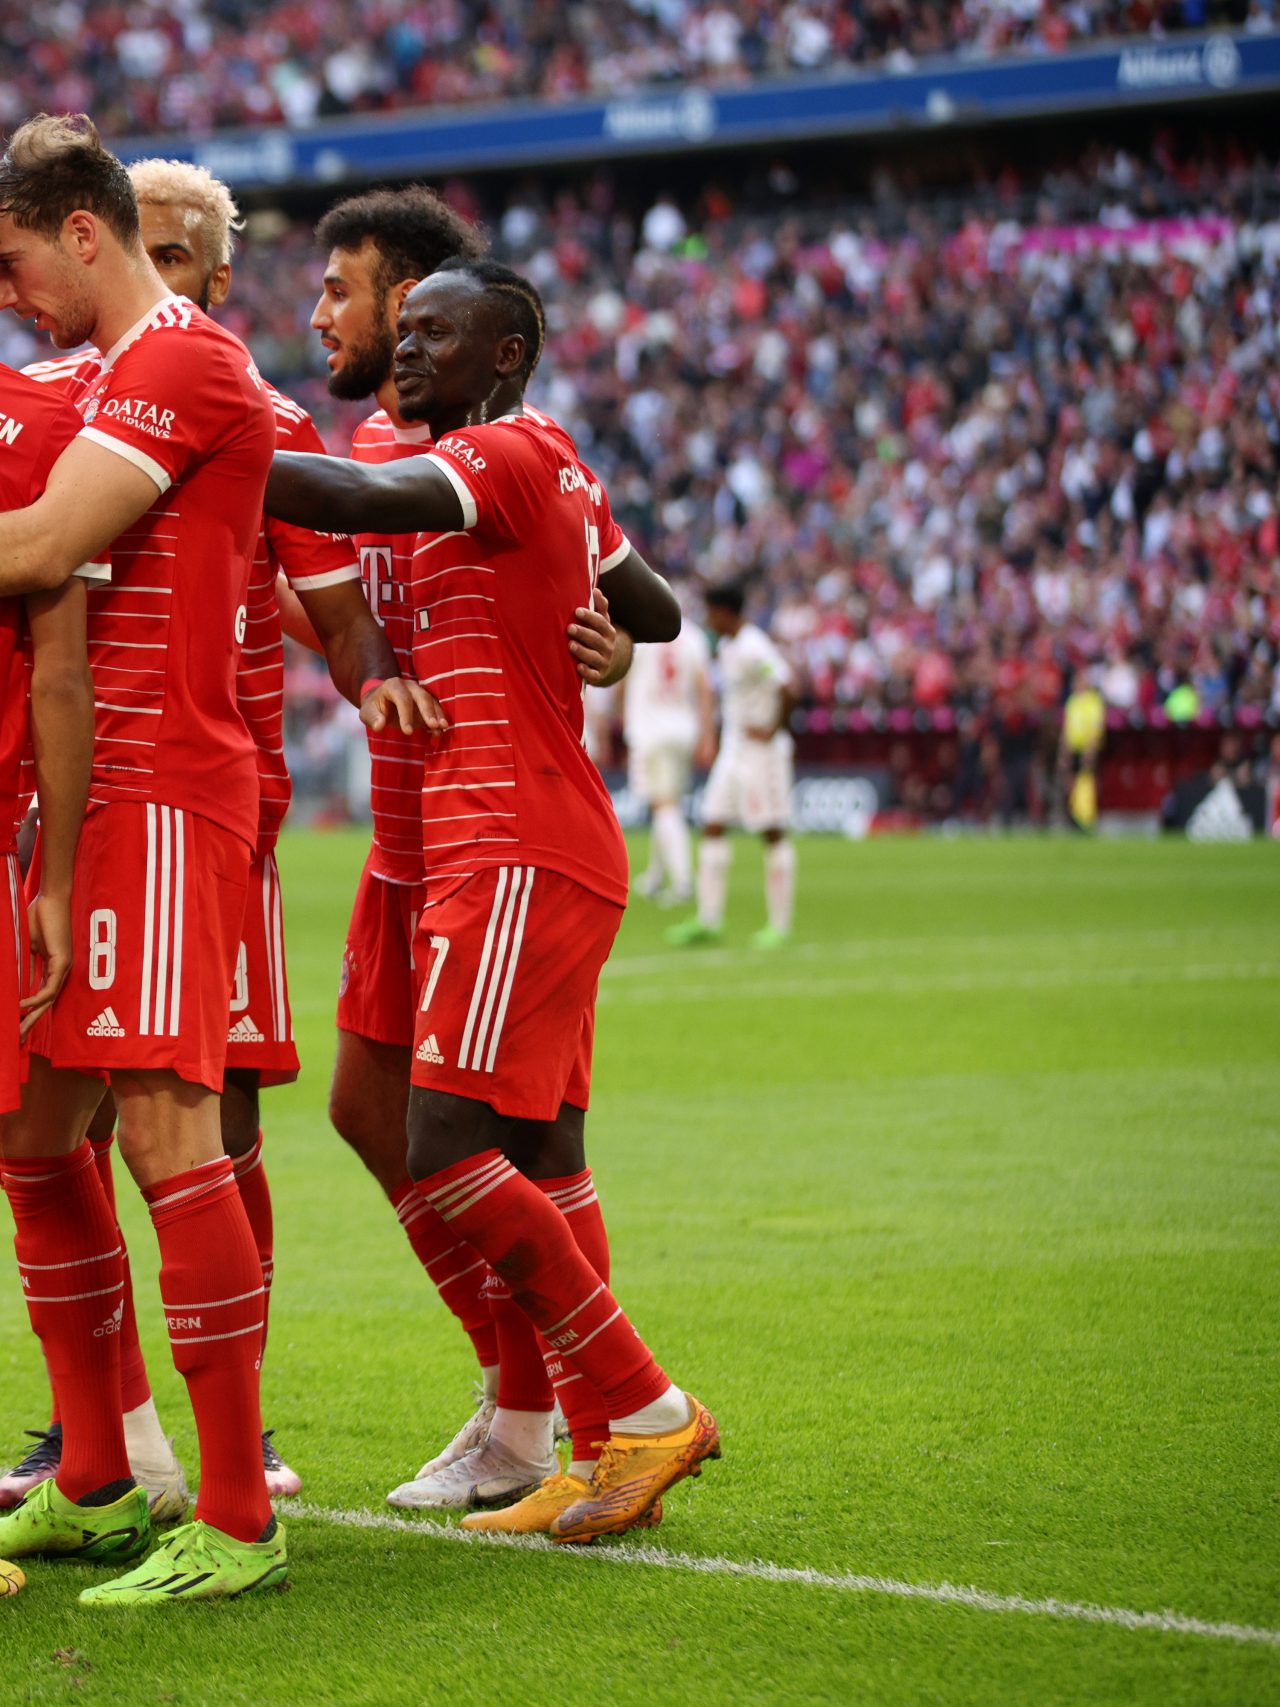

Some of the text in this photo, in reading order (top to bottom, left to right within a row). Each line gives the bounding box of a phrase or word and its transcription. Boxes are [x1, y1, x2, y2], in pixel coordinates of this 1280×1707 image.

[102, 398, 176, 430] QATAR
[88, 908, 117, 990] 8
[87, 1026, 125, 1037] adidas
[416, 1051, 445, 1065] adidas
